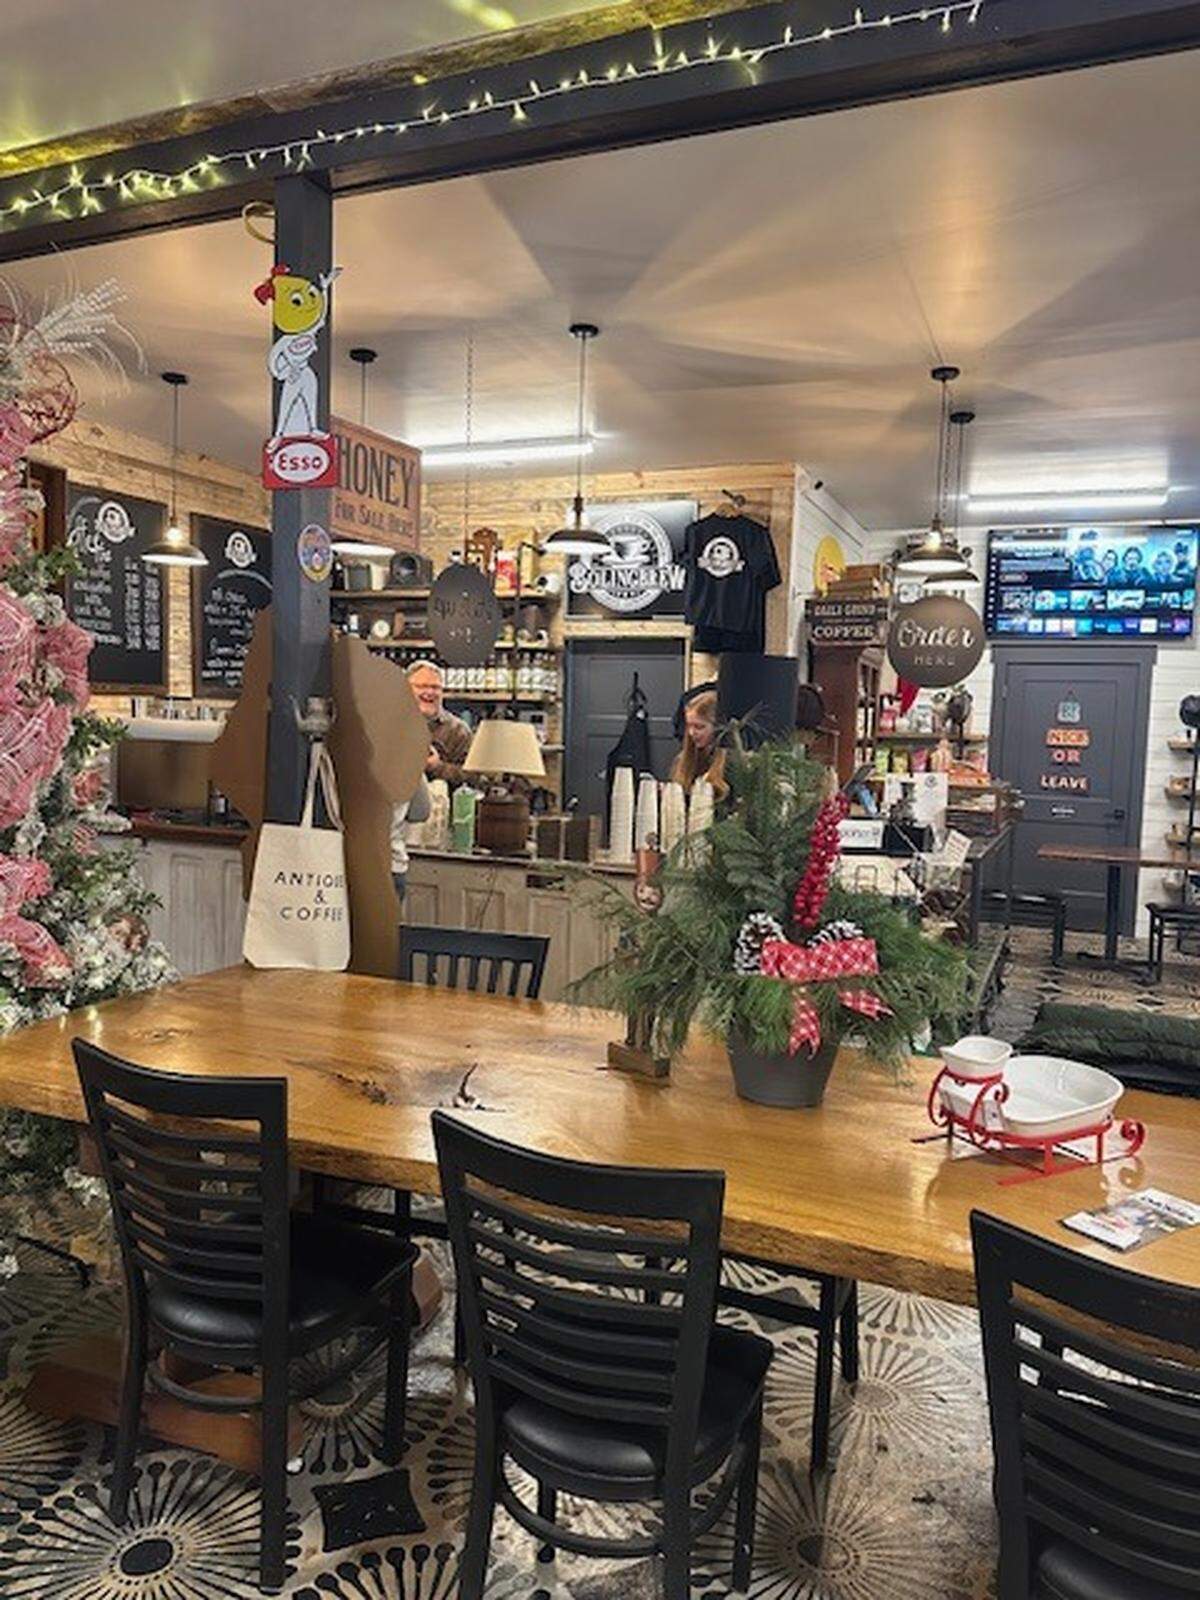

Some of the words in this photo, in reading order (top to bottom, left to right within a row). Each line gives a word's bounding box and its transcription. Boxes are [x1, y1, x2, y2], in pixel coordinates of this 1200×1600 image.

[335, 434, 415, 508] HONEY
[813, 624, 875, 638] COFFEE
[898, 619, 976, 648] Order
[1052, 749, 1081, 763] OR
[1040, 774, 1089, 791] LEAVE
[313, 889, 328, 905] &
